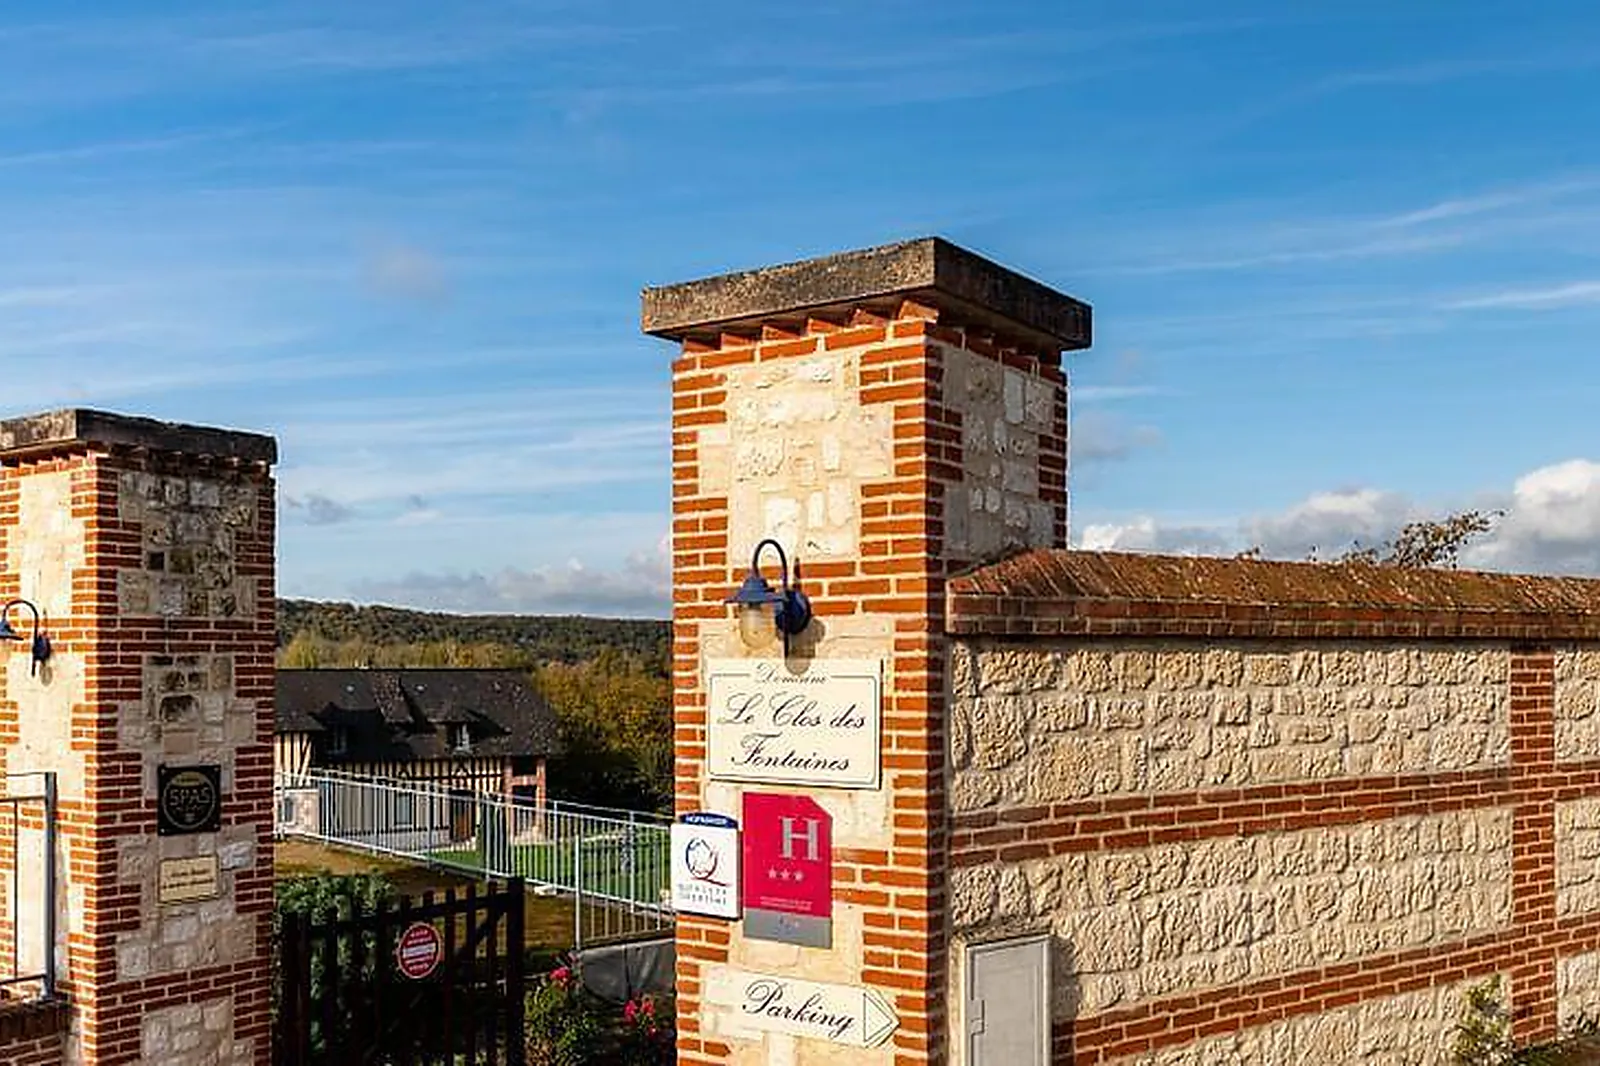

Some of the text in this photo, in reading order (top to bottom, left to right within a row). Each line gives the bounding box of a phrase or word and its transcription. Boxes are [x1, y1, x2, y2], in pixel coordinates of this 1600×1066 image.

[717, 691, 866, 729] Le Clos des
[731, 731, 849, 770] Fontaines
[778, 815, 823, 862] H
[742, 979, 855, 1042] Parking
